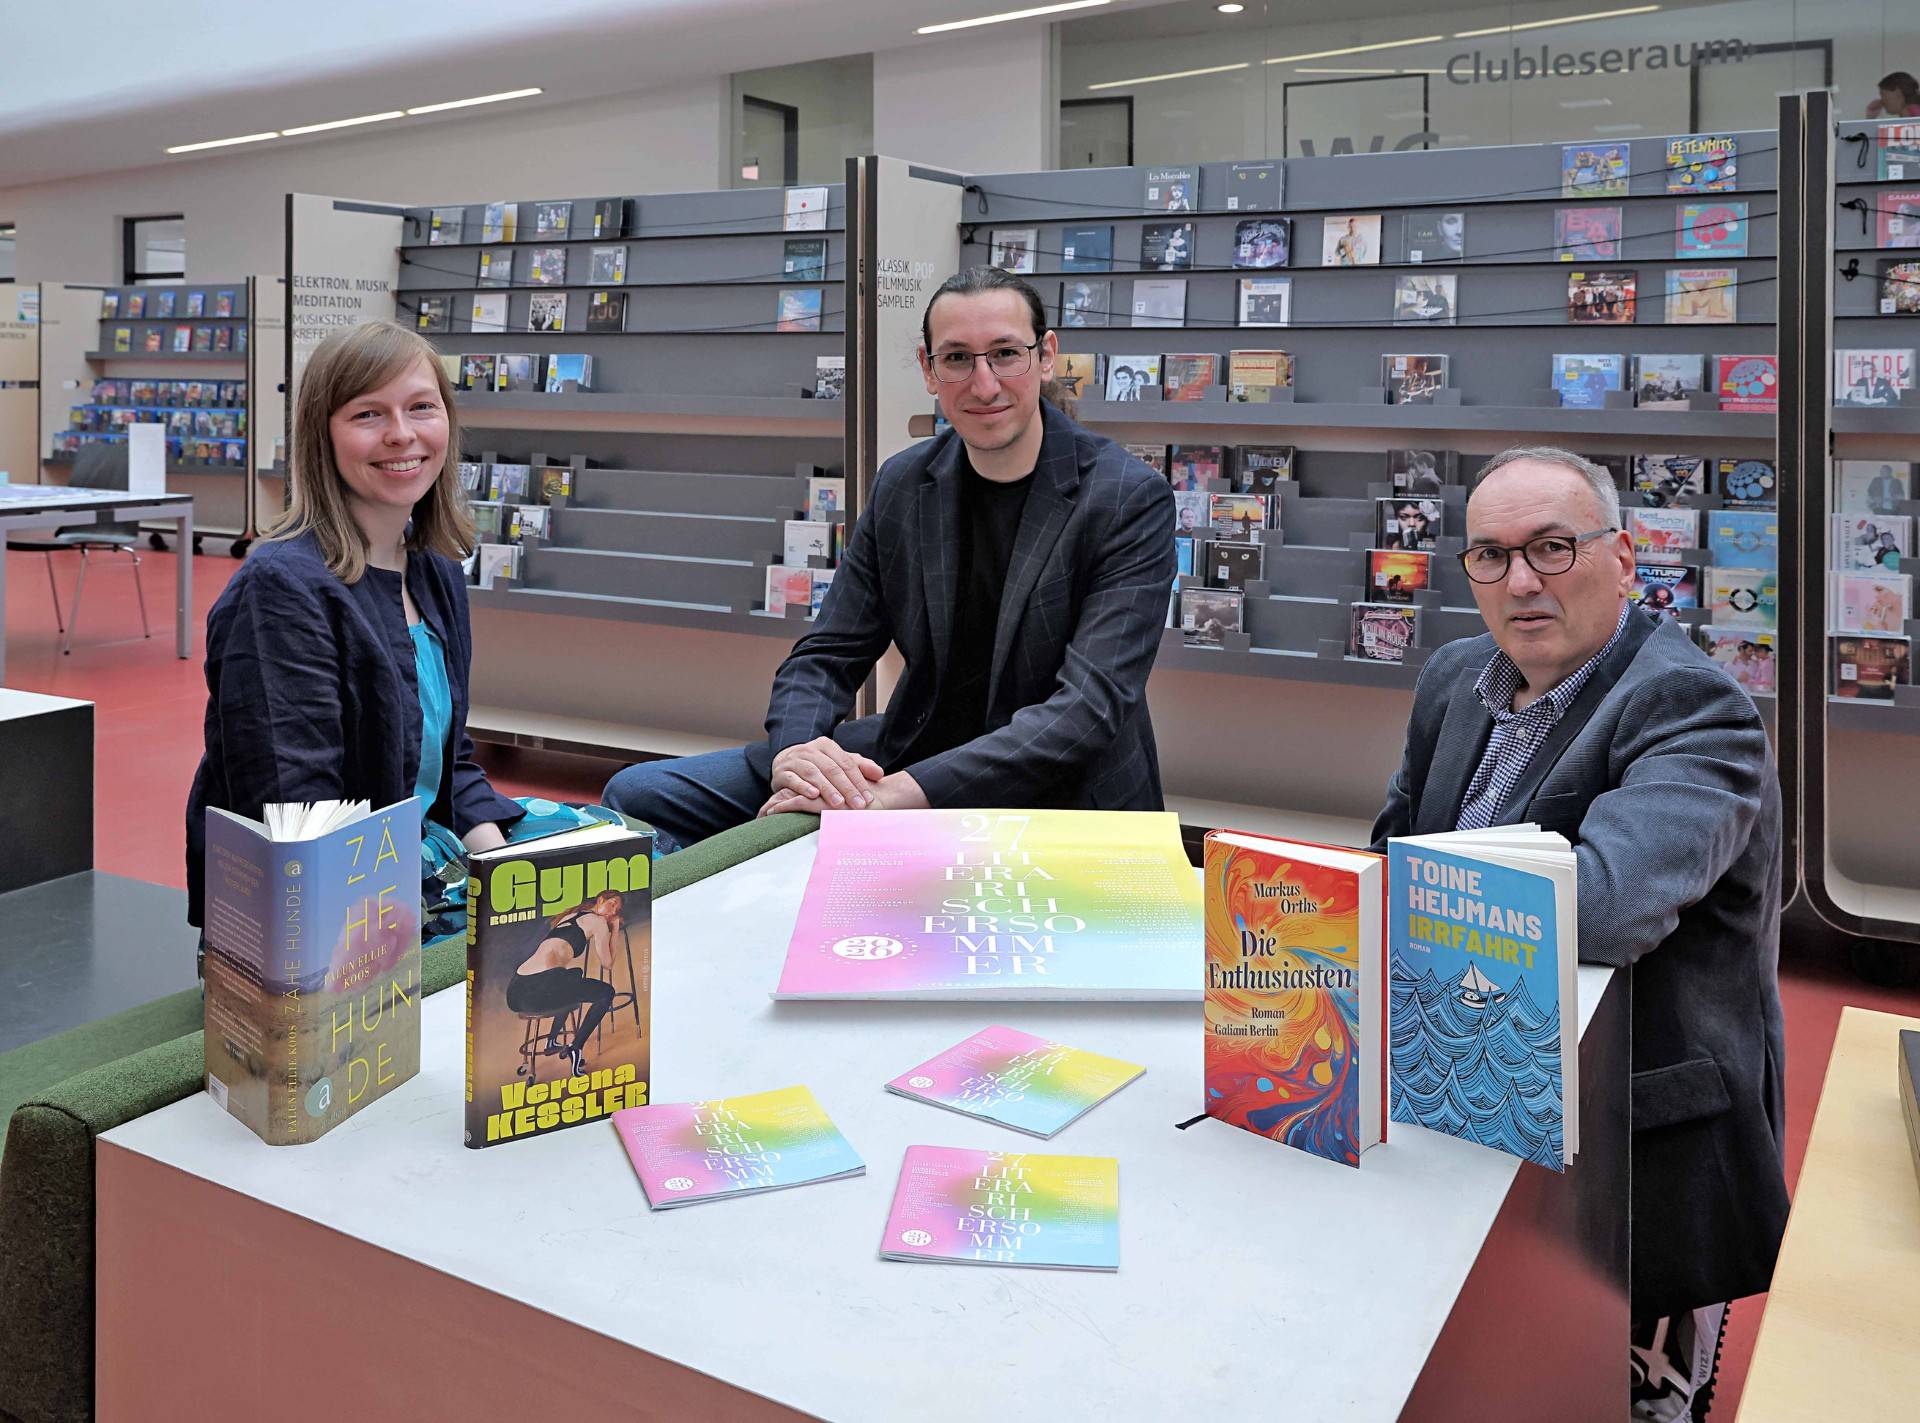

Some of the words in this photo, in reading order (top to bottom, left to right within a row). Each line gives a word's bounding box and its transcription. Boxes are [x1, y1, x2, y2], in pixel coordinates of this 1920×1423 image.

[1446, 37, 1744, 85] Clubleseraum
[877, 259, 910, 273] KLASSIK
[293, 275, 353, 291] ELEKTRON.
[355, 279, 390, 293] MUSIK
[877, 276, 922, 292] FILMMUSIK
[293, 294, 363, 310] MEDITATION
[877, 294, 916, 309] SAMPLER
[293, 313, 357, 326] MUSIKSZENE
[960, 813, 1032, 853] 27
[346, 816, 399, 885] ZÄ
[944, 866, 1056, 881] ERA
[1406, 855, 1483, 897] TOINE
[490, 853, 651, 917] Gym
[974, 880, 1027, 898] RI
[1254, 882, 1301, 899] Markus
[941, 897, 1059, 915] SCH
[1280, 897, 1318, 914] Orths
[1409, 885, 1544, 941] HEIJMANS
[285, 885, 301, 951] HUNDE
[345, 885, 398, 951] HE
[924, 915, 1087, 935] ERSO
[953, 935, 1060, 954] MM
[1241, 930, 1277, 958] Die
[1409, 914, 1538, 969] IRRFAHRT
[1409, 942, 1431, 954] ROMAN
[357, 943, 388, 968] ELLIE
[960, 955, 1051, 976] ER
[344, 967, 370, 990] KOOS
[1209, 961, 1352, 990] Enthusiasten
[282, 959, 301, 1014] ZÄHE
[332, 969, 412, 1054] HUN
[1251, 1007, 1286, 1020] Roman
[1214, 1023, 1249, 1037] Galiani
[1250, 1024, 1279, 1037] Berlin
[287, 1024, 298, 1056] KOOS
[348, 1042, 396, 1105] DE
[984, 1071, 1032, 1093] SCH
[500, 1063, 637, 1111] Verena
[960, 1077, 1026, 1102] ERSO
[487, 1081, 648, 1142] KESSLER
[693, 1108, 739, 1125] LIT
[694, 1120, 753, 1137] ERA
[713, 1132, 745, 1146] RI
[705, 1141, 765, 1159] SCH
[704, 1151, 782, 1172] ERSO
[723, 1164, 776, 1181] MM
[981, 1165, 1034, 1180] LIT
[972, 1177, 1036, 1194] ERA
[985, 1191, 1018, 1207] RI
[967, 1204, 1033, 1221] SCH
[955, 1217, 1043, 1236] ERSO
[969, 1233, 1024, 1251] MM
